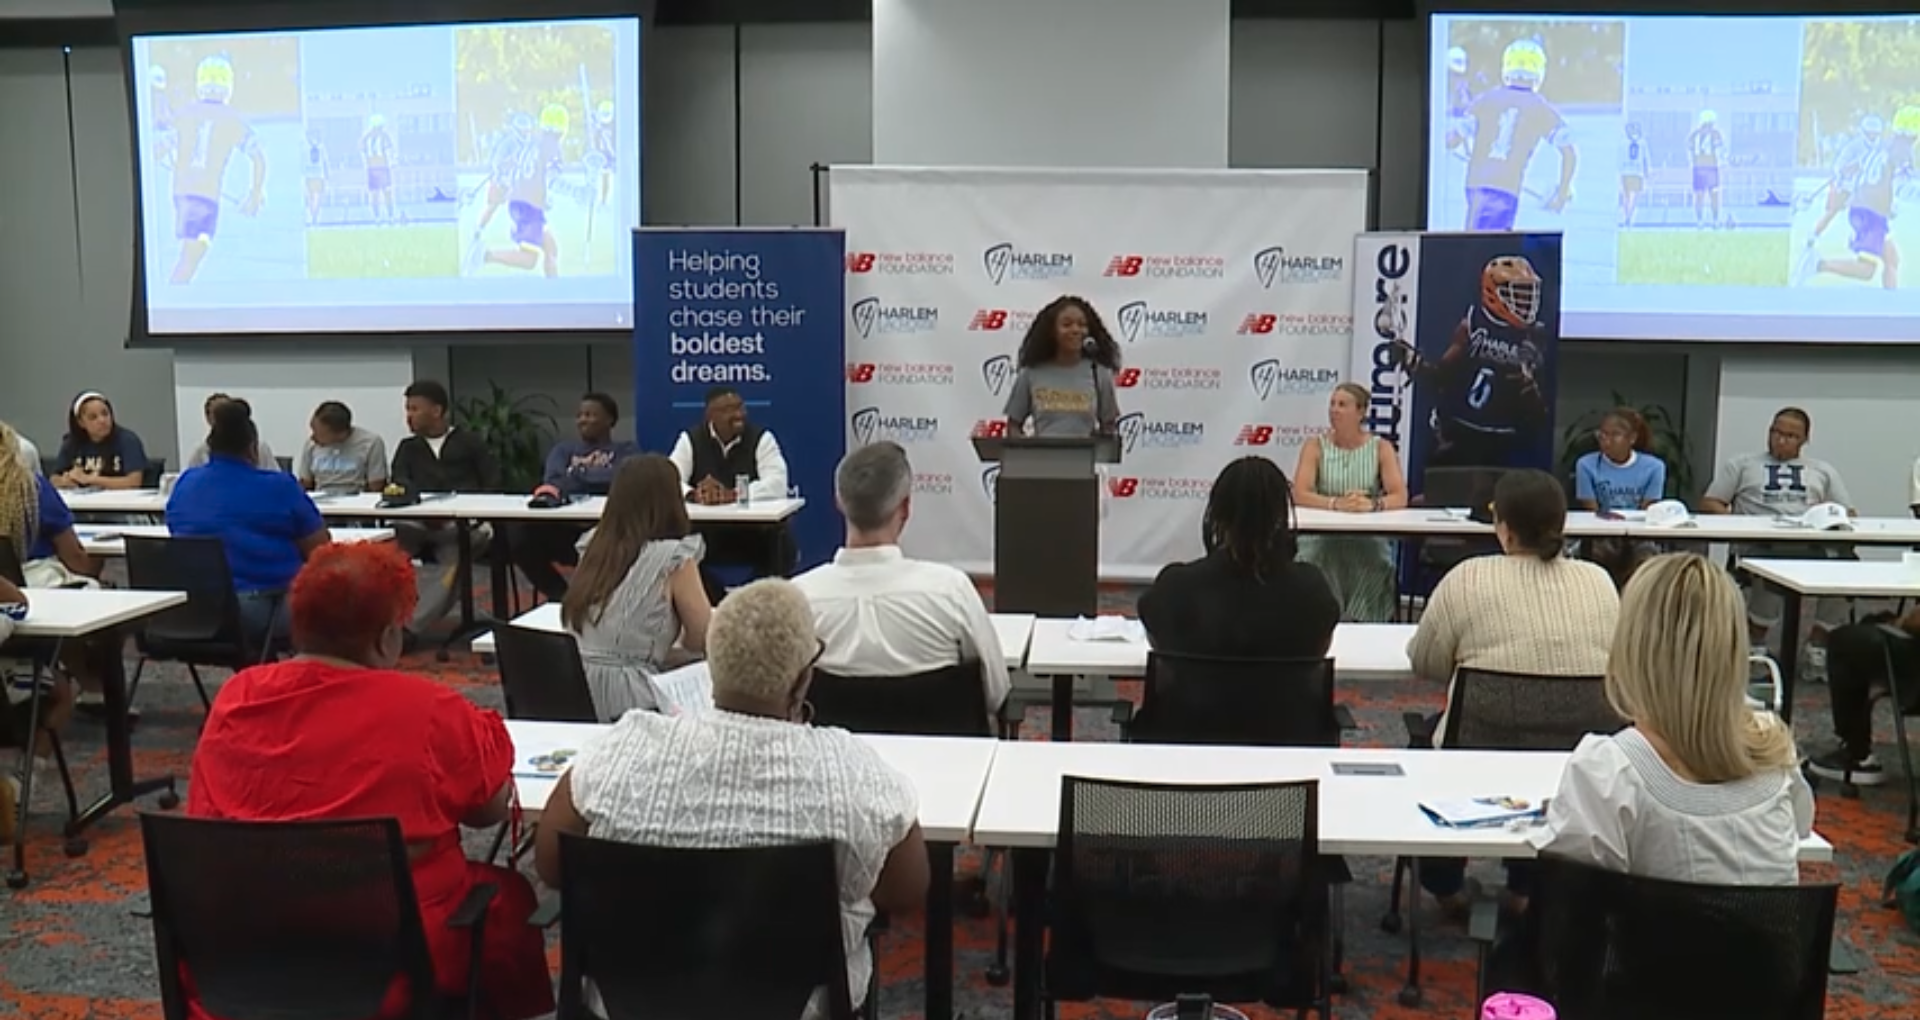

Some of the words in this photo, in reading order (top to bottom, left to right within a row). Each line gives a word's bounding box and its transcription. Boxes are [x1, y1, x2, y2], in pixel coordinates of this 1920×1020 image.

[879, 253, 902, 262] new
[905, 252, 954, 262] balance
[1011, 252, 1073, 266] HARLEM
[1146, 257, 1171, 266] new
[1174, 256, 1223, 266] balance
[1281, 256, 1342, 270] HARLEM
[669, 249, 760, 279] Helping
[879, 264, 954, 274] FOUNDATION
[1146, 267, 1223, 278] FOUNDATION
[669, 278, 779, 299] students
[669, 306, 743, 327] chase
[751, 306, 806, 326] their
[879, 307, 938, 320] HARLEM
[1145, 310, 1207, 324] HARLEM
[1280, 314, 1305, 323] new
[671, 332, 765, 354] boldest
[671, 359, 772, 382] dreams.
[879, 364, 902, 372] new
[905, 362, 953, 373] balance
[1145, 368, 1168, 377] new
[1171, 368, 1221, 378] balance
[879, 374, 953, 385] FOUNDATION
[1279, 368, 1338, 382] HARLEM
[1145, 378, 1220, 389] FOUNDATION
[879, 417, 938, 430] HARLEM
[1142, 422, 1203, 435] HARLEM
[1277, 426, 1301, 434] new
[1764, 464, 1806, 491] H
